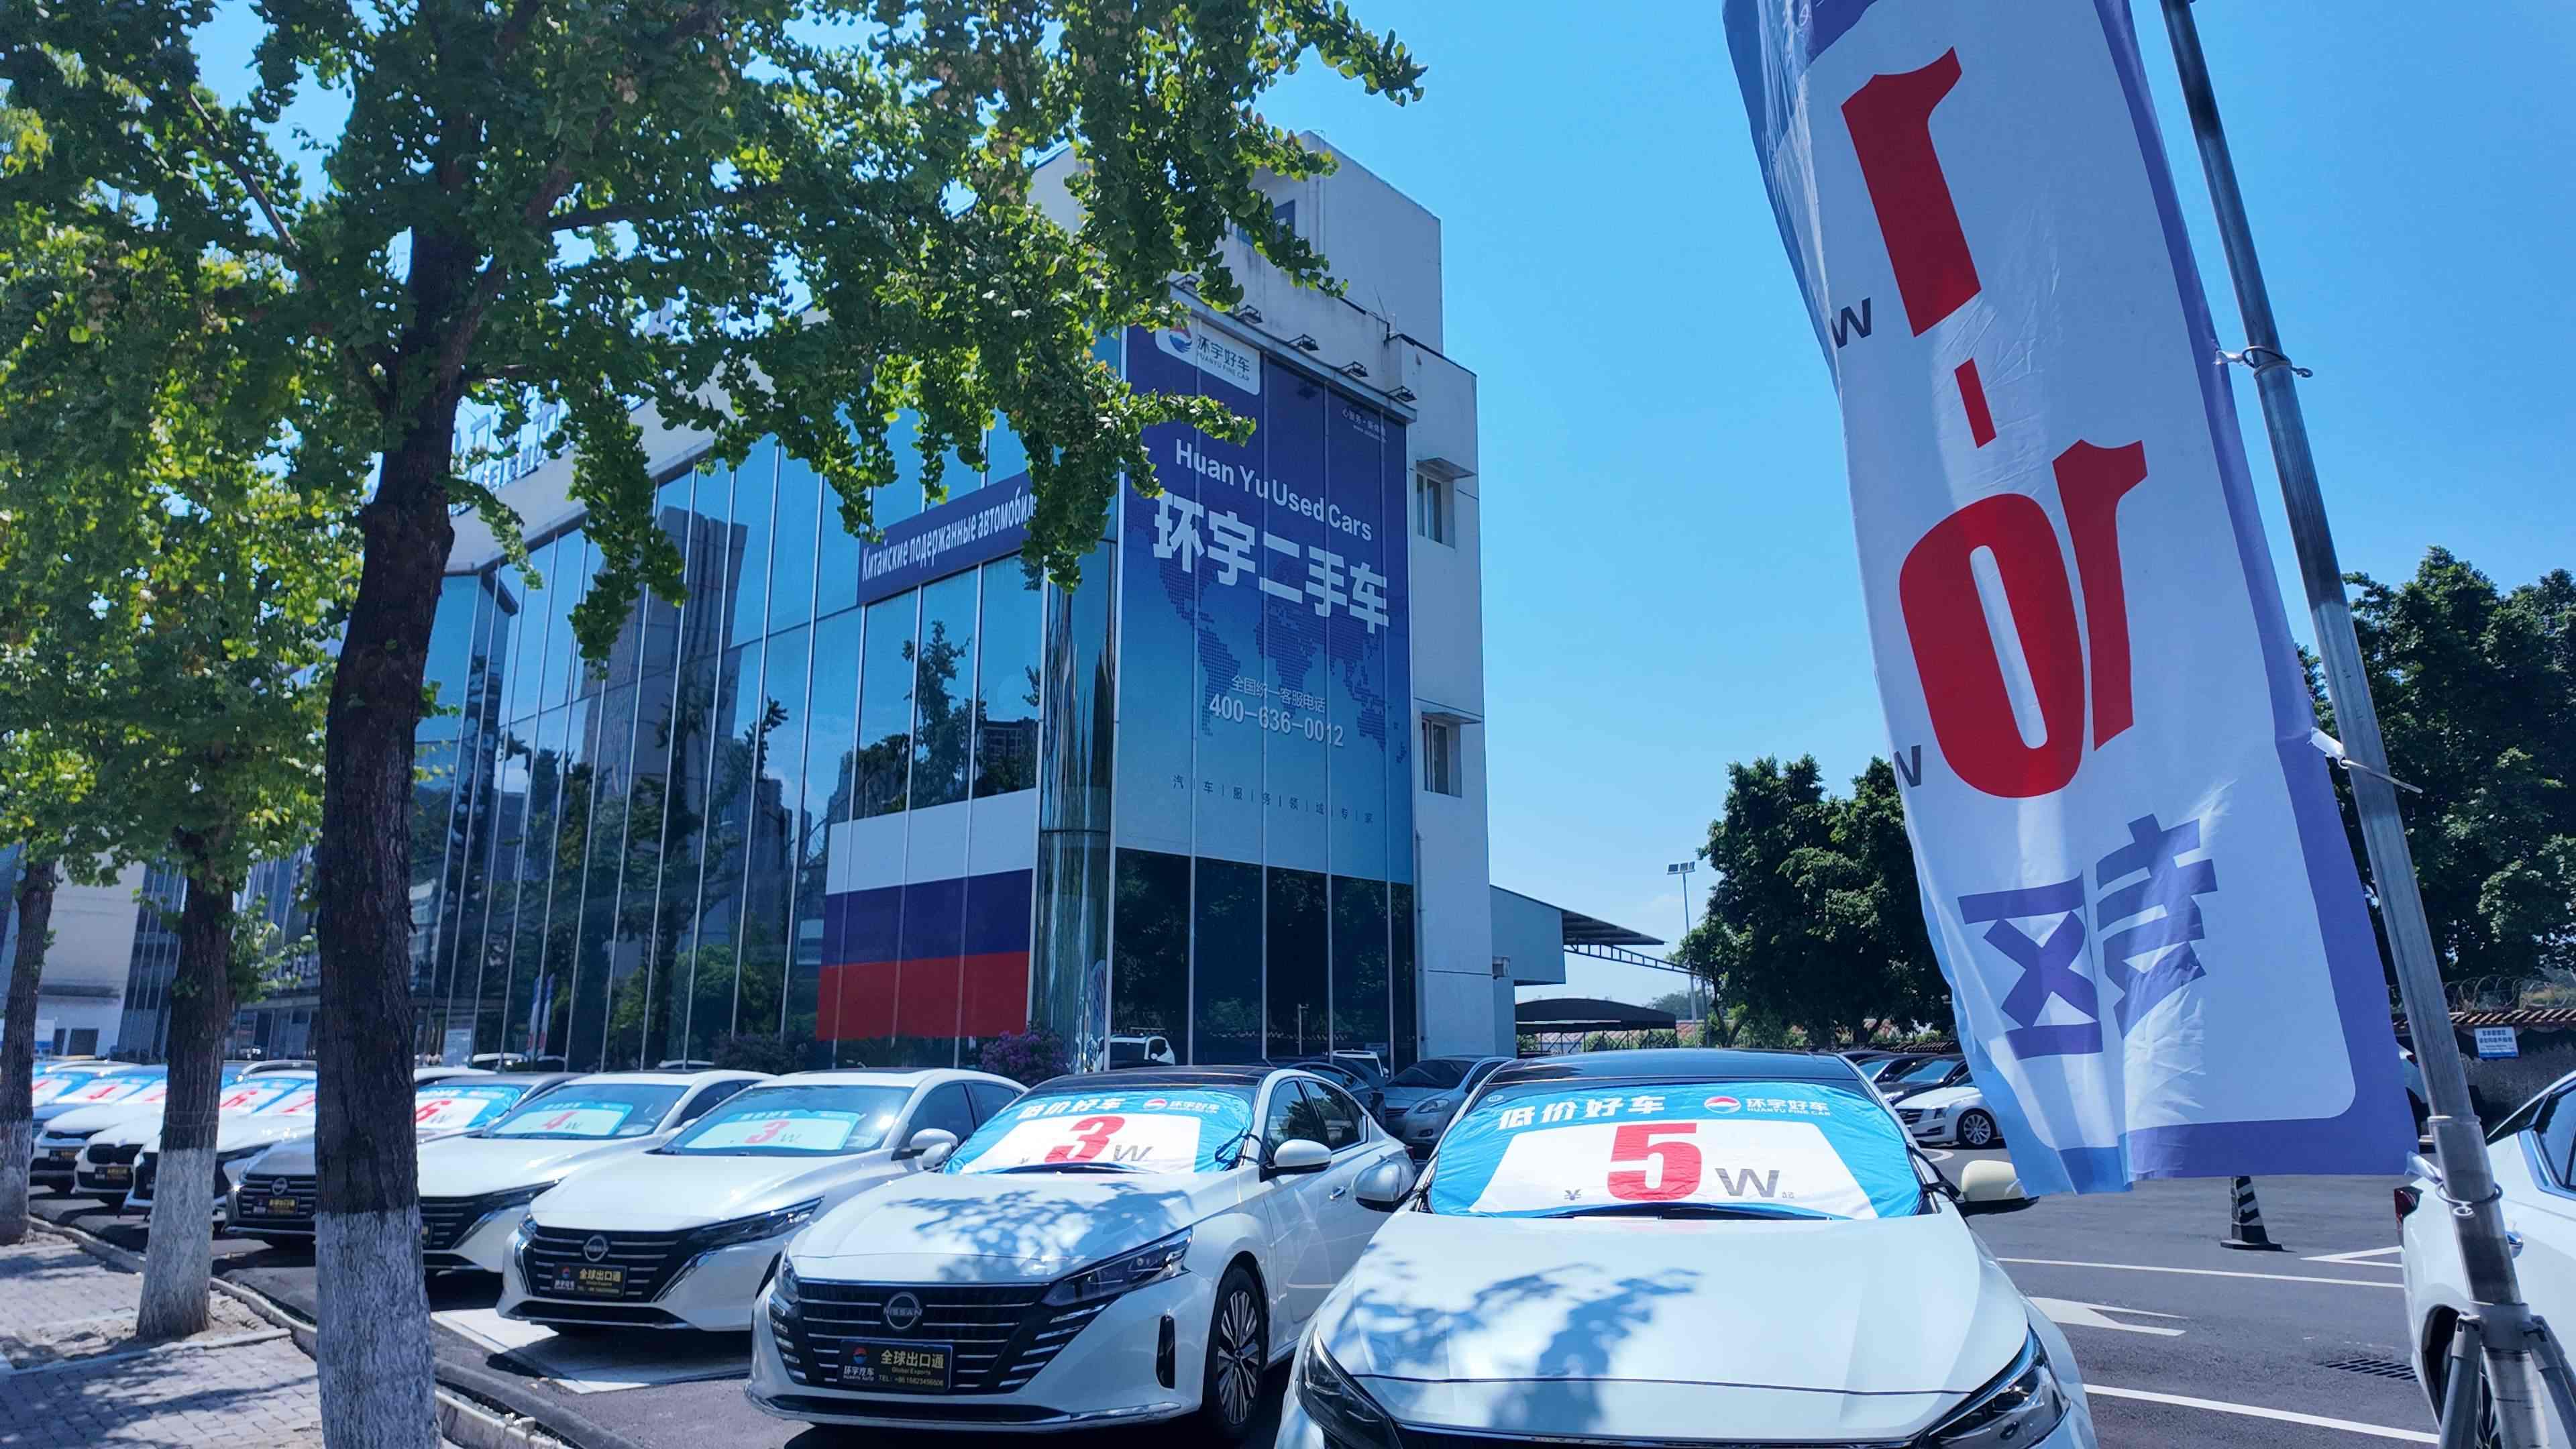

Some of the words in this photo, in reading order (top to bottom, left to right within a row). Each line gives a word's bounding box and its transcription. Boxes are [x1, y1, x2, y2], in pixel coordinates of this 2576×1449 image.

[1197, 333, 1250, 373] 环宇好车
[1175, 438, 1234, 486] Huan
[1239, 465, 1269, 500] Yu
[1273, 478, 1325, 523] Used
[1328, 504, 1373, 541] Cars
[861, 539, 908, 582] Китайские
[910, 515, 977, 568] подержанные
[977, 486, 1037, 539] автомобил
[1153, 490, 1389, 635] 环宇二手车
[1231, 674, 1326, 714] 全国统一客服电话
[1497, 1095, 1666, 1130] 低价好车
[1746, 1097, 1829, 1112] 环宇好车
[744, 1120, 792, 1144] 3
[1044, 1116, 1126, 1163] 3
[1112, 1144, 1154, 1162] W
[1607, 1122, 1702, 1201] 5
[1715, 1167, 1780, 1198] W
[883, 1307, 924, 1317] NISSAN
[880, 1348, 945, 1369] 全球出口通
